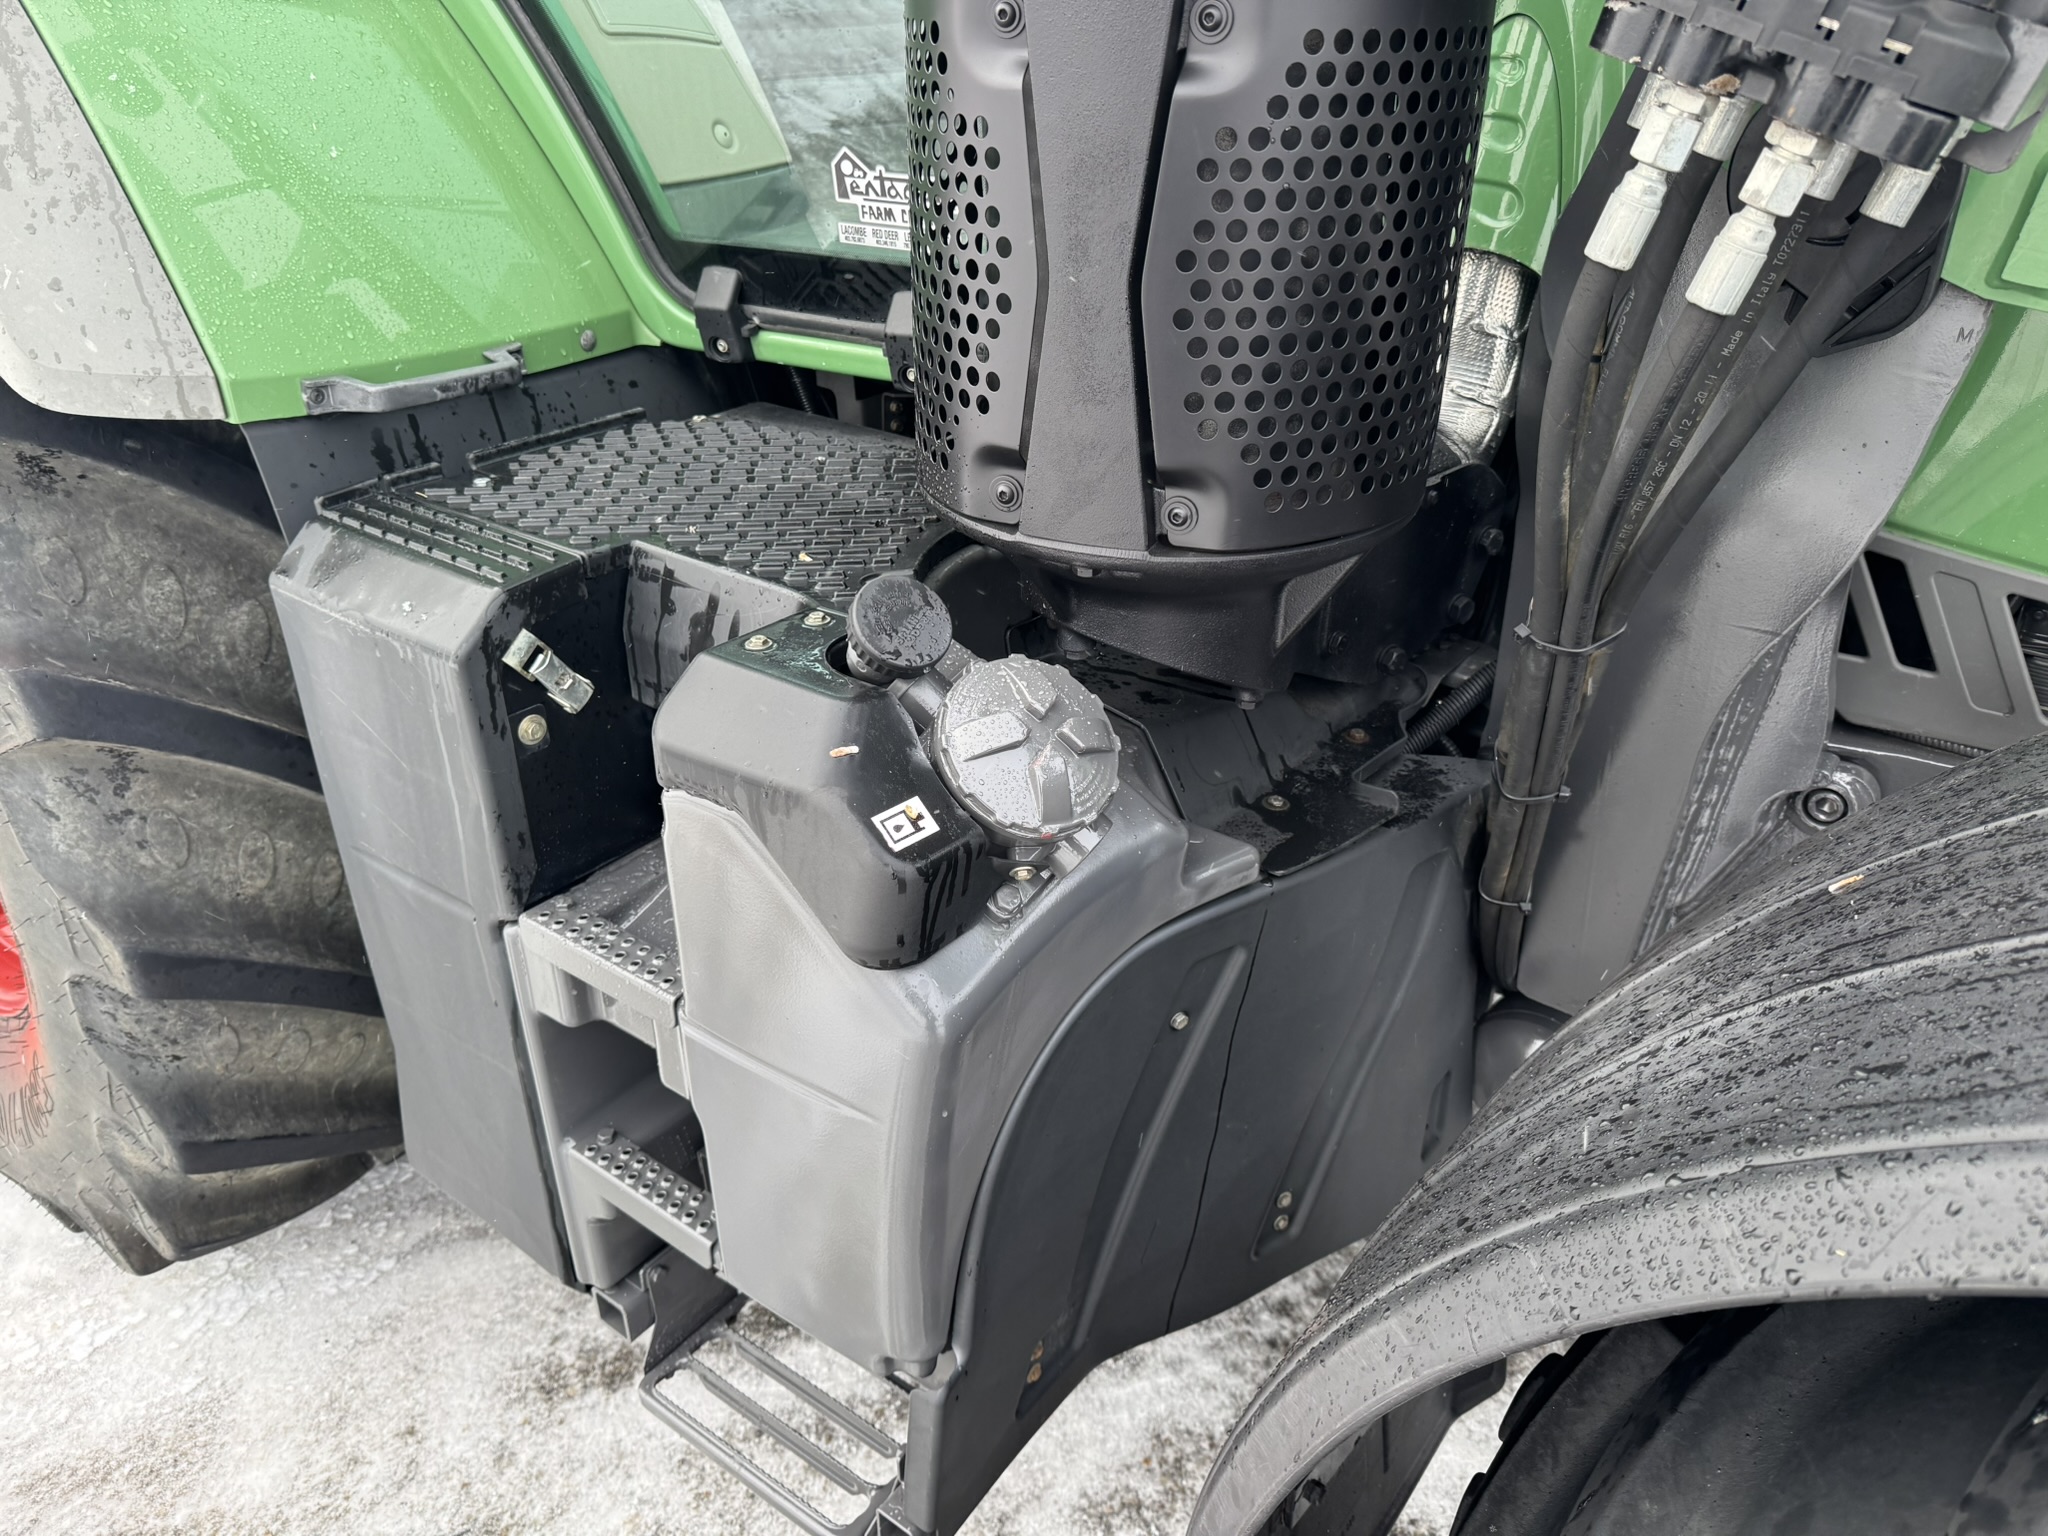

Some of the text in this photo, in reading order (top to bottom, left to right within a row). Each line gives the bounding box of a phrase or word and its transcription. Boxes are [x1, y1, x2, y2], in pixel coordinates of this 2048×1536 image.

[861, 205, 897, 222] FARM
[841, 225, 868, 238] LACOMBE
[872, 228, 883, 240] RED
[884, 230, 899, 242] DEER
[1956, 326, 1975, 343] M
[1634, 500, 1647, 512] EN
[1642, 480, 1656, 498] 857
[1652, 461, 1668, 478] 2SC
[1669, 435, 1683, 448] DN
[1679, 419, 1692, 431] 12
[1721, 330, 1743, 357] Made
[1741, 311, 1754, 323] in
[1751, 272, 1776, 305] Italy
